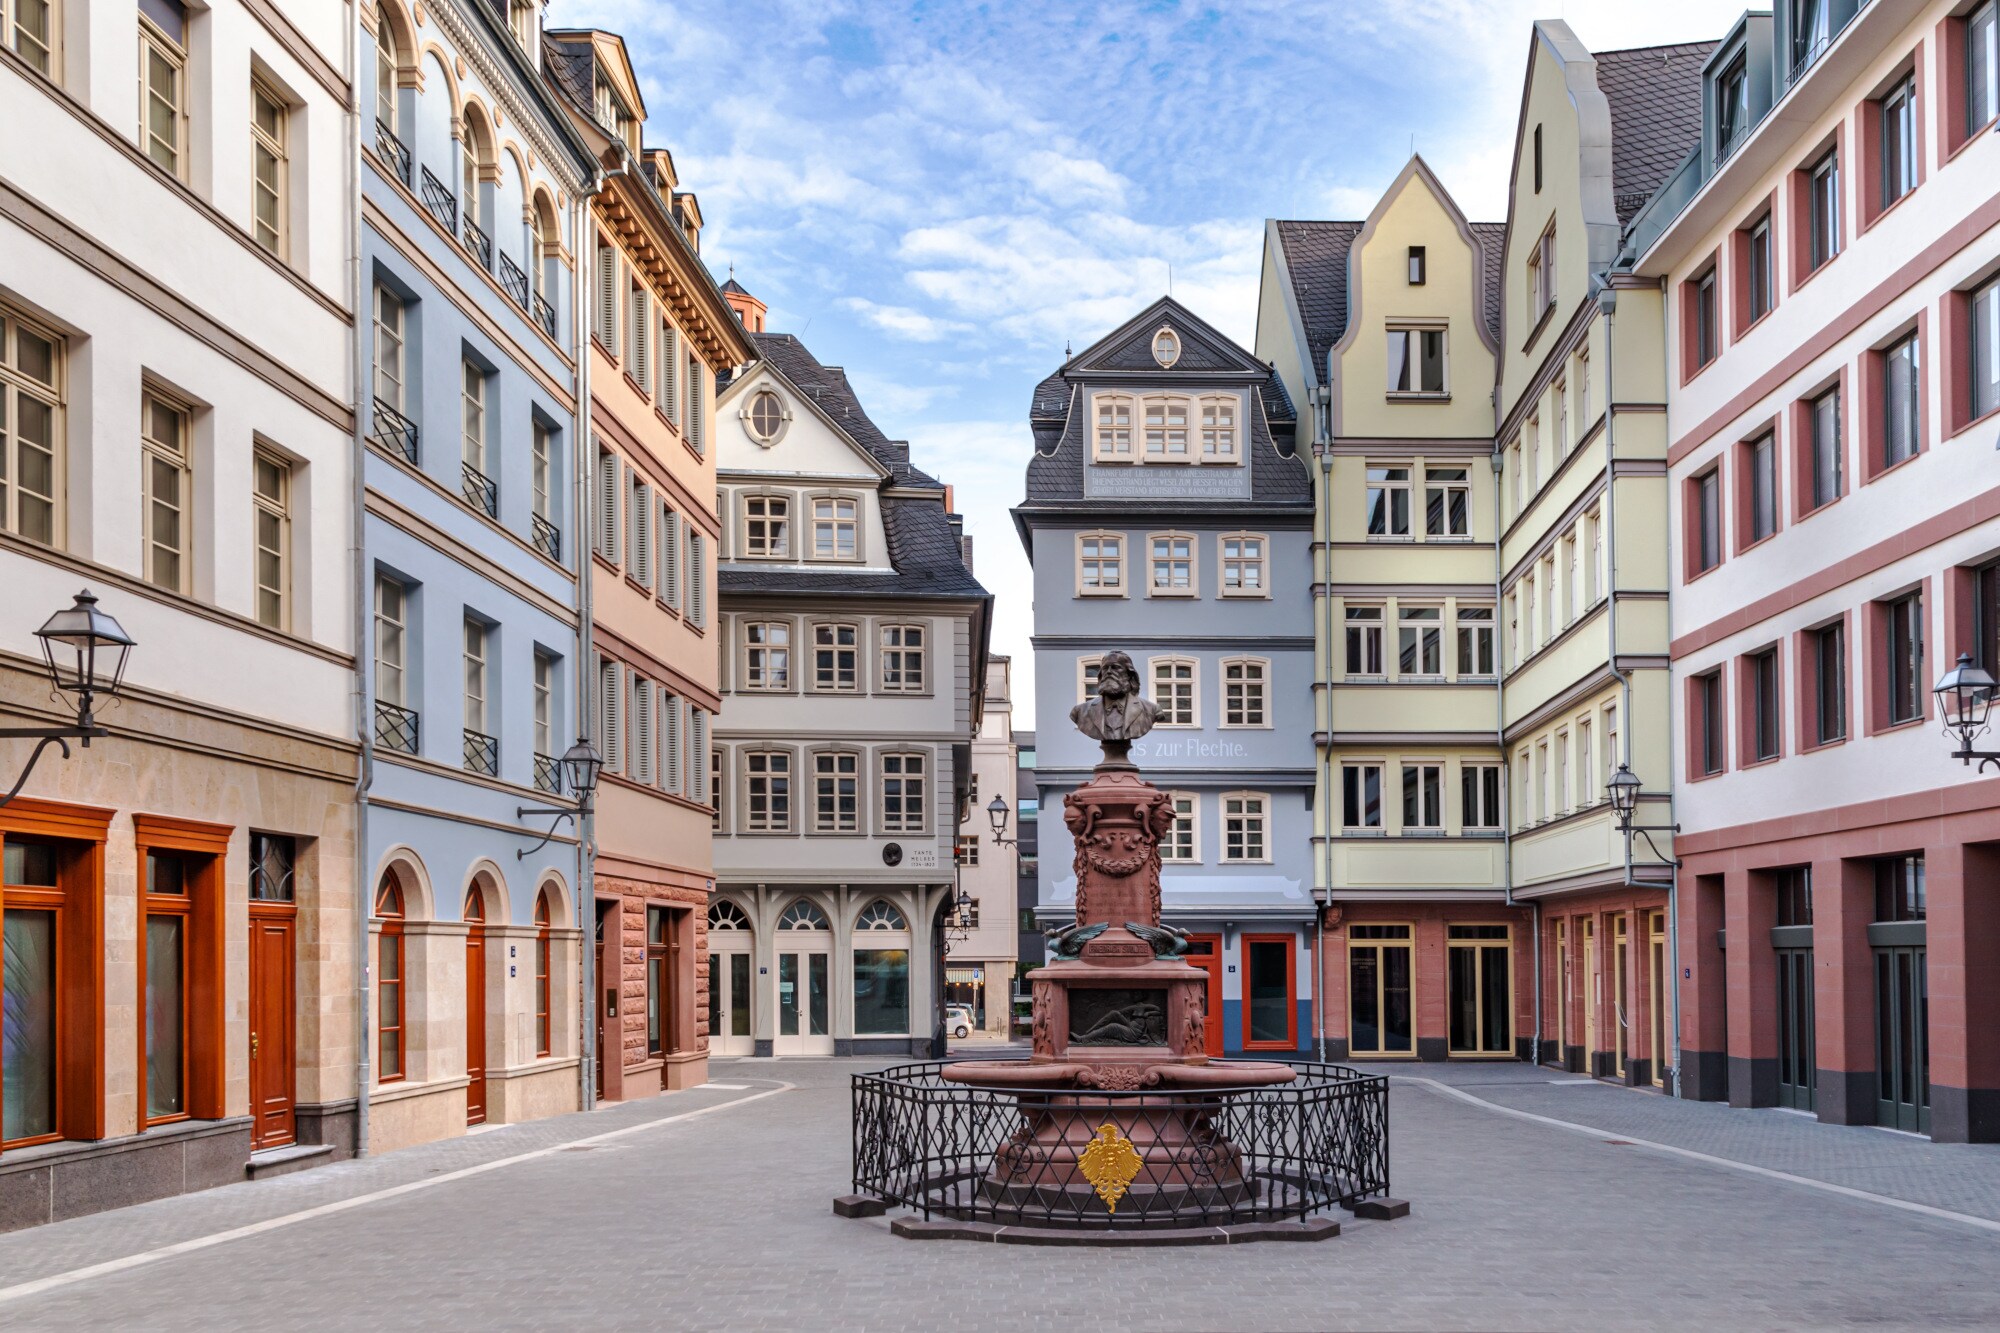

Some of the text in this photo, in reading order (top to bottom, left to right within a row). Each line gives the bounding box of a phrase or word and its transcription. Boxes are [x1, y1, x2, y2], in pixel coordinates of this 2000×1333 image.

[1092, 469, 1132, 477] FRANKFURT
[1233, 470, 1243, 478] AM
[1115, 486, 1147, 494] VERSTAND
[1227, 487, 1242, 495] ESEL
[1155, 743, 1182, 757] zur
[1187, 739, 1248, 757] Flechte.
